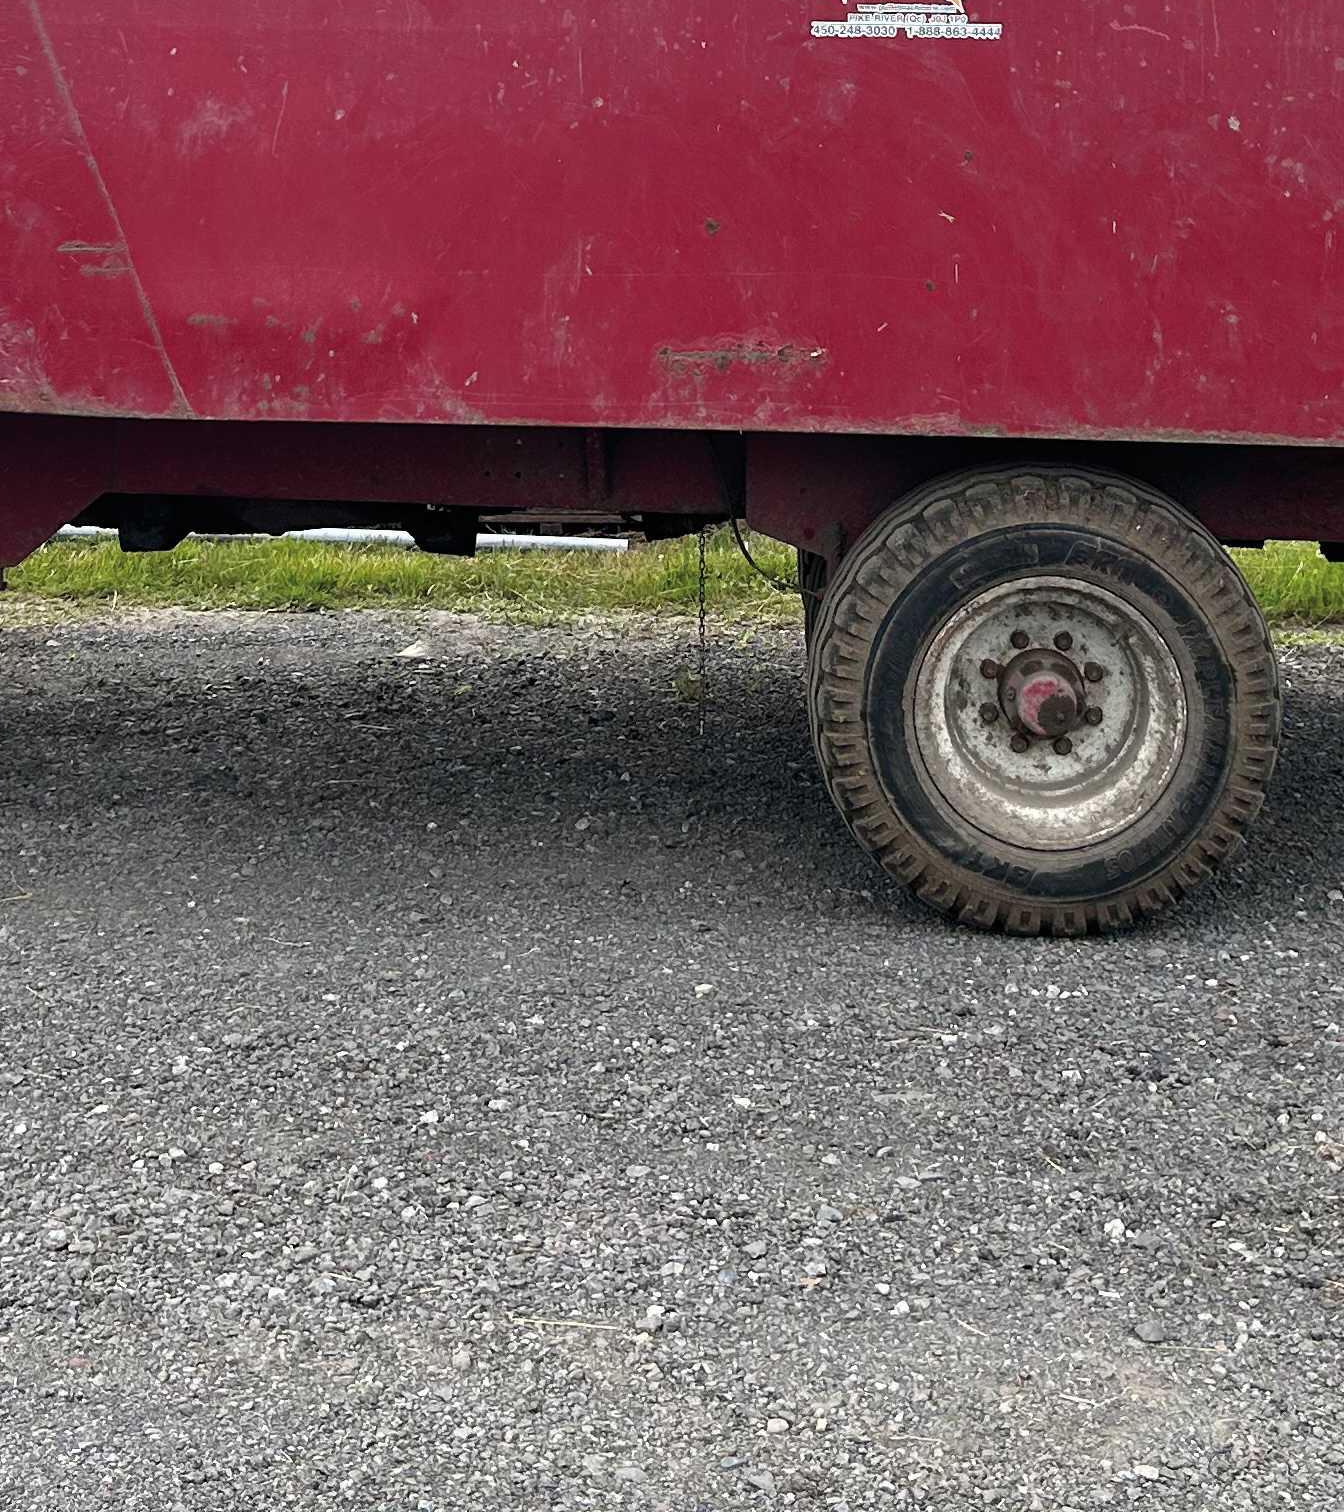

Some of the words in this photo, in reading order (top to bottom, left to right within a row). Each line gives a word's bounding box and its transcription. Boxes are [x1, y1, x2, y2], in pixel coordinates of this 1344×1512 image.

[874, 14, 904, 23] RIVER
[813, 24, 896, 36] 450-248-3030
[906, 26, 1001, 37] 1-888-863-4444
